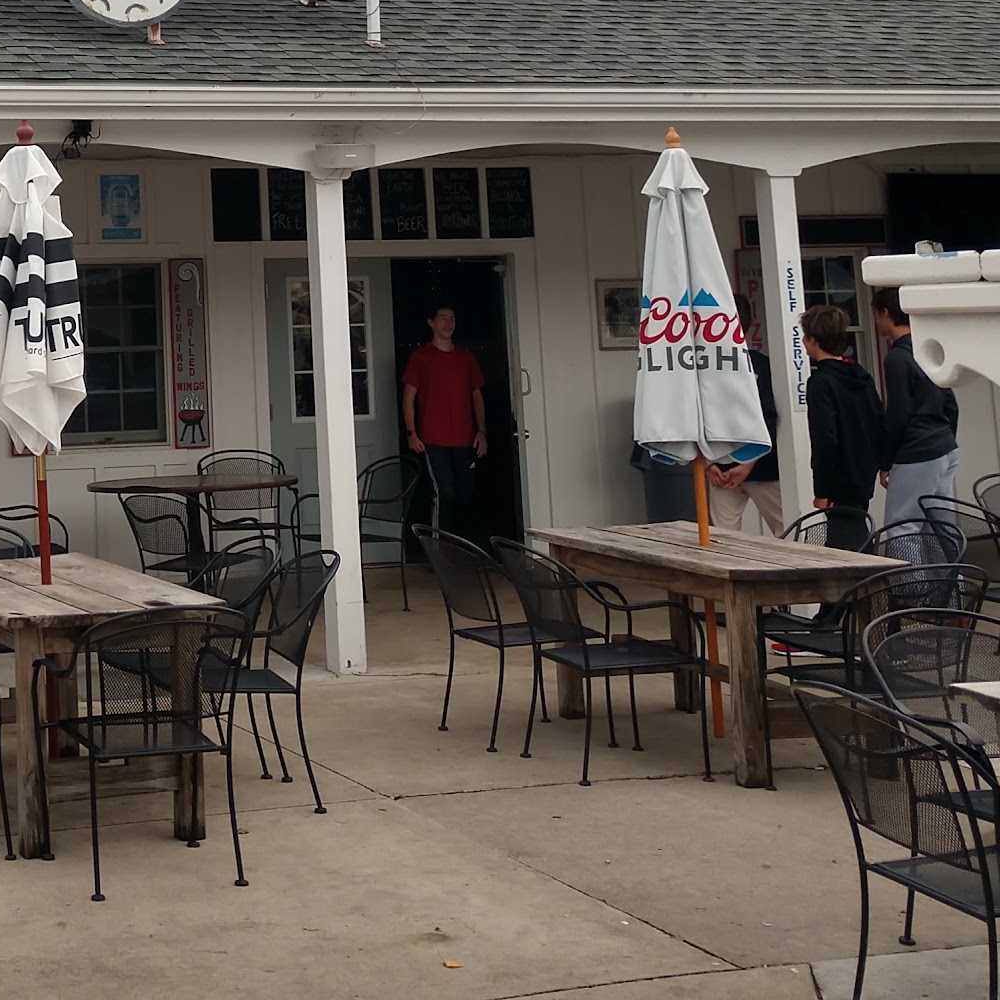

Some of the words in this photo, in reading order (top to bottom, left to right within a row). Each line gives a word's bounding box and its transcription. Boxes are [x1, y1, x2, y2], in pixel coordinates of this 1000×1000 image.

[272, 212, 303, 231] FREE
[397, 215, 427, 233] BEER
[174, 284, 184, 373] FEATURING
[186, 309, 197, 377] GRILLED
[786, 267, 797, 313] SELF
[792, 326, 807, 405] SERVICE
[176, 382, 205, 392] WINGS
